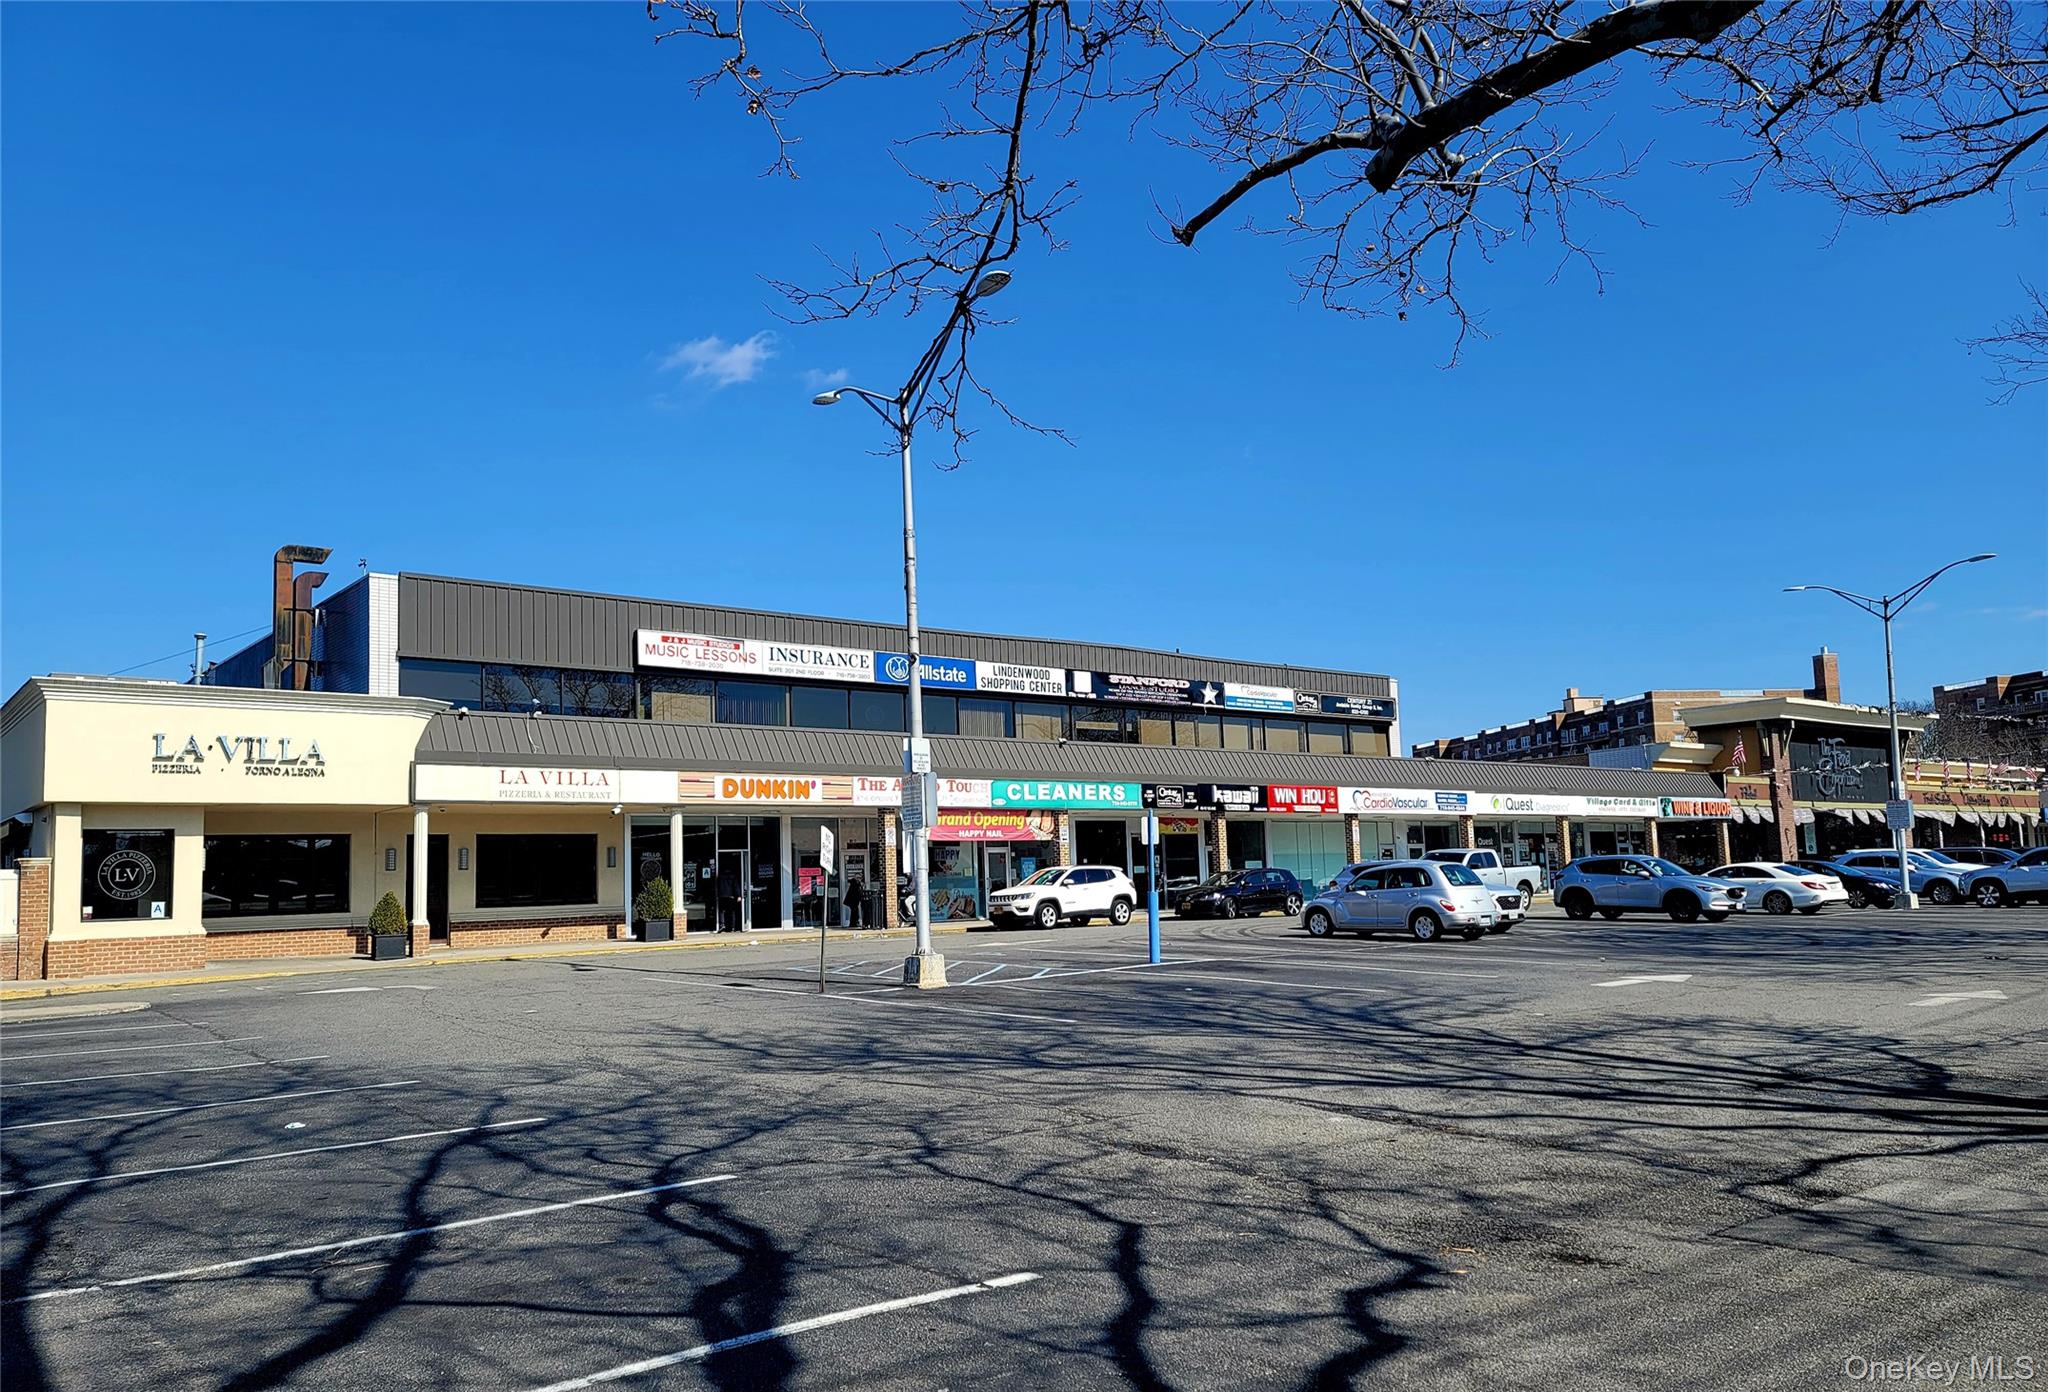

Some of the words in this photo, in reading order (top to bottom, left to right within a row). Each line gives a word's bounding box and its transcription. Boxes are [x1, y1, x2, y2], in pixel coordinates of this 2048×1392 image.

[645, 644, 689, 658] MUSIC
[695, 648, 757, 664] LESSONS
[768, 647, 870, 669] INSURANCE
[919, 666, 967, 683] Allstate
[993, 665, 1050, 680] LINDENWOOD
[981, 677, 1025, 691] SHOPPING
[1029, 681, 1063, 693] CENTER
[1108, 674, 1190, 689] STANFORD
[151, 733, 205, 763] LA
[215, 735, 327, 766] VILLA
[151, 764, 201, 775] PIZZERIA
[245, 766, 281, 777] FORNO
[499, 769, 528, 784] LA
[540, 771, 610, 786] VILLA
[722, 778, 816, 800] DUNKIN'
[857, 777, 887, 791] THE
[499, 789, 542, 799] PIZZERIA
[545, 790, 552, 799] &
[554, 791, 612, 800] RESTAURANT
[1007, 783, 1126, 801] CLEANERS
[1212, 784, 1260, 804] kawaii
[1273, 787, 1298, 804] WIN
[1302, 788, 1326, 804] HOU
[1363, 797, 1428, 809] CardioVascular
[1505, 797, 1534, 811] Quest
[1586, 797, 1612, 806] Village
[1613, 798, 1631, 806] Card
[937, 812, 972, 826] rand
[974, 811, 1025, 829] Opening
[959, 830, 983, 838] HAPPY
[984, 830, 1003, 838] NAIL
[935, 849, 960, 861] HAPPY
[153, 904, 162, 913] A
